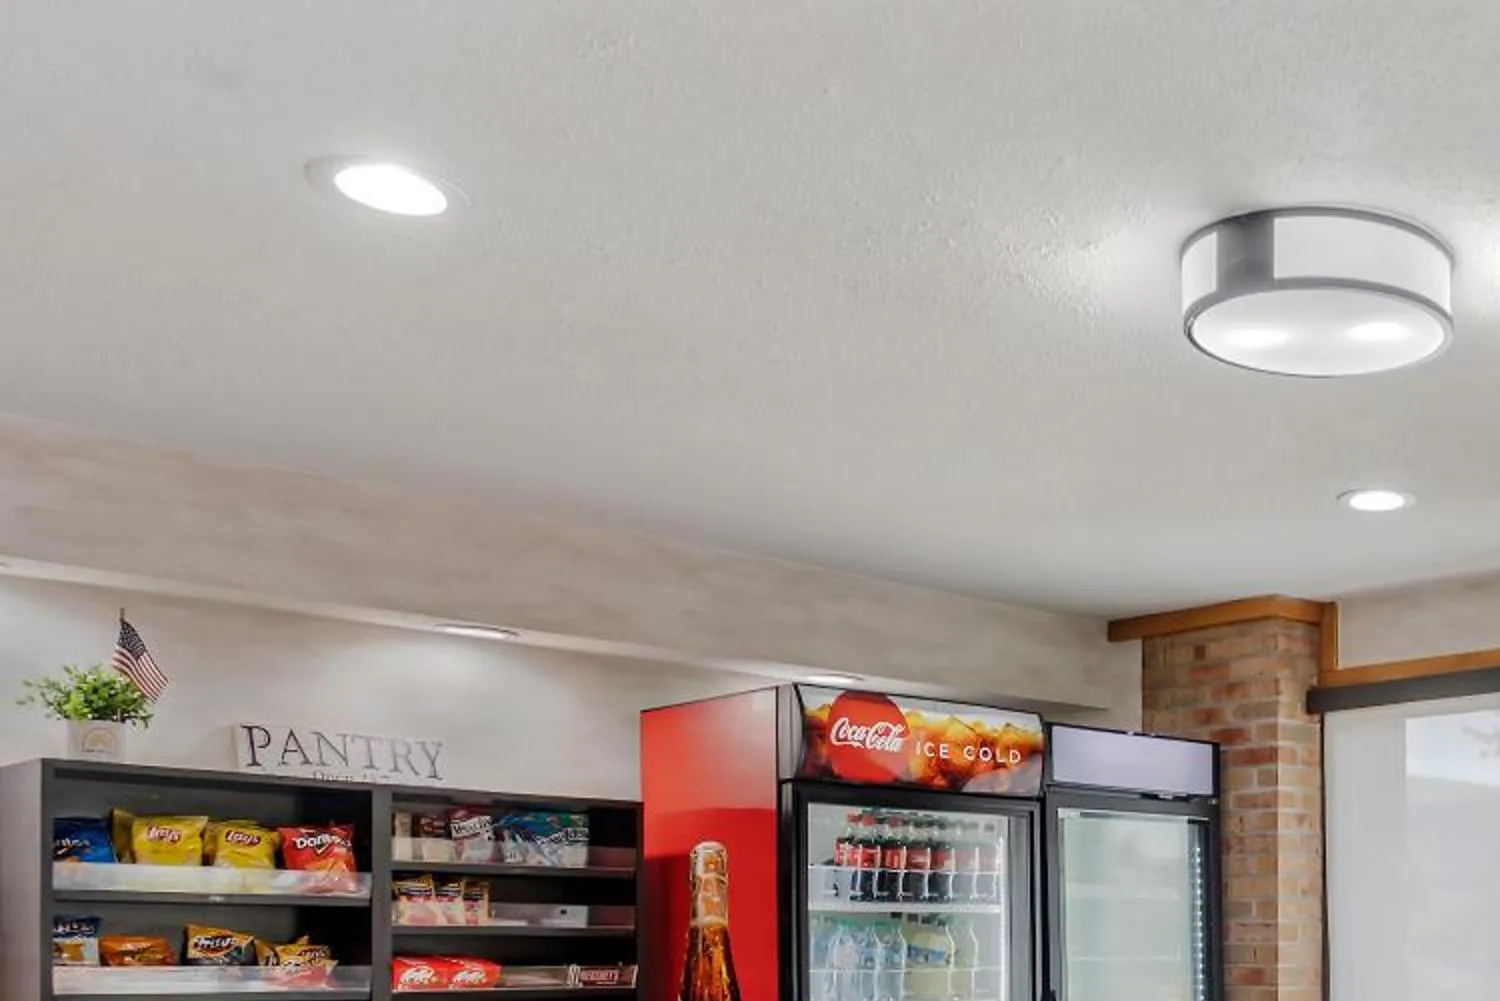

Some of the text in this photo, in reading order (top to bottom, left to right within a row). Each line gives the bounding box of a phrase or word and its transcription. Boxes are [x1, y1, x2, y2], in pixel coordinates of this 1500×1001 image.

[831, 717, 905, 752] Coca-Cola
[241, 725, 443, 780] PANTRY
[916, 742, 1021, 763] ICE COLD
